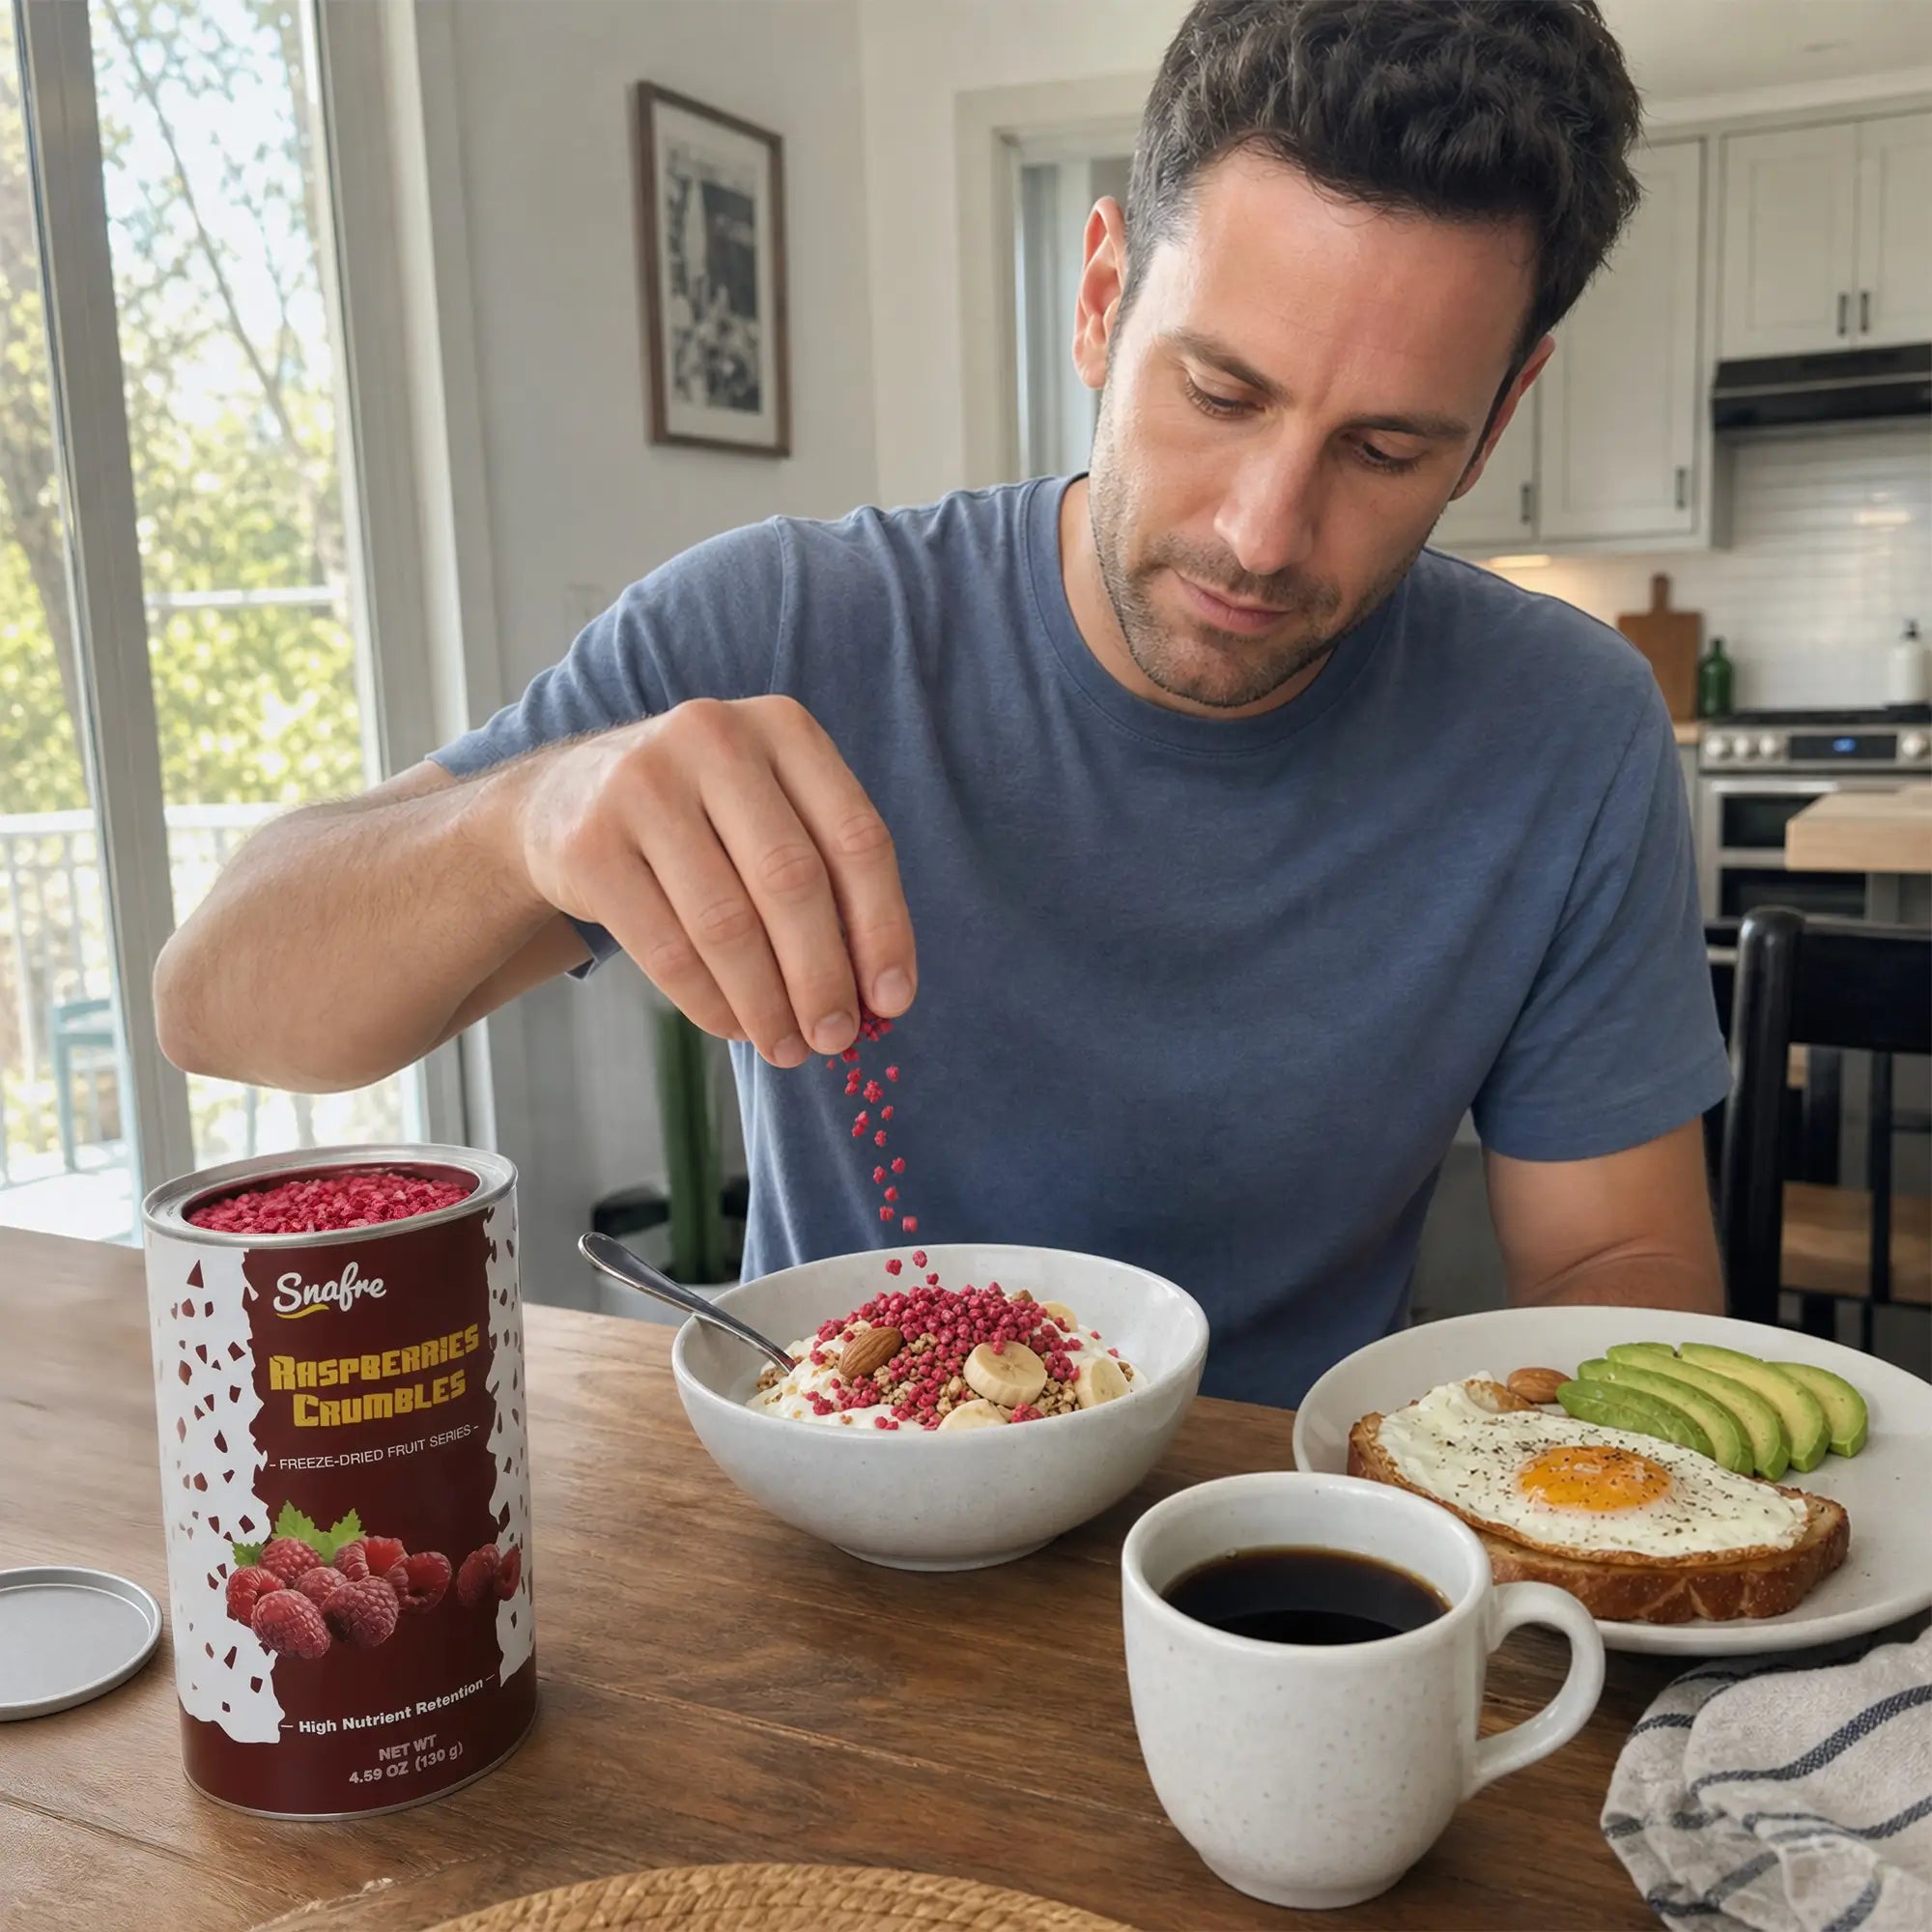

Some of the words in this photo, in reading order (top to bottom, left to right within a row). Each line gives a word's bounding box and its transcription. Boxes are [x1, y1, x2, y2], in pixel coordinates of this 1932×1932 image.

[273, 1261, 386, 1312] Snafre
[269, 1322, 479, 1390] RASPBERRIES
[293, 1369, 466, 1427] CRUMBLES
[279, 1449, 384, 1470] FREEZE-DRIED
[387, 1438, 425, 1458] FRUIT
[429, 1424, 471, 1447] SERIES
[298, 1719, 337, 1735] High
[342, 1706, 412, 1731] Nutrient
[415, 1678, 484, 1715] Retention
[349, 1767, 383, 1784] 4.59
[386, 1761, 410, 1777] OZ
[414, 1748, 446, 1773] (130
[448, 1742, 464, 1760] g)
[379, 1742, 410, 1761] NET
[413, 1734, 437, 1753] WT
